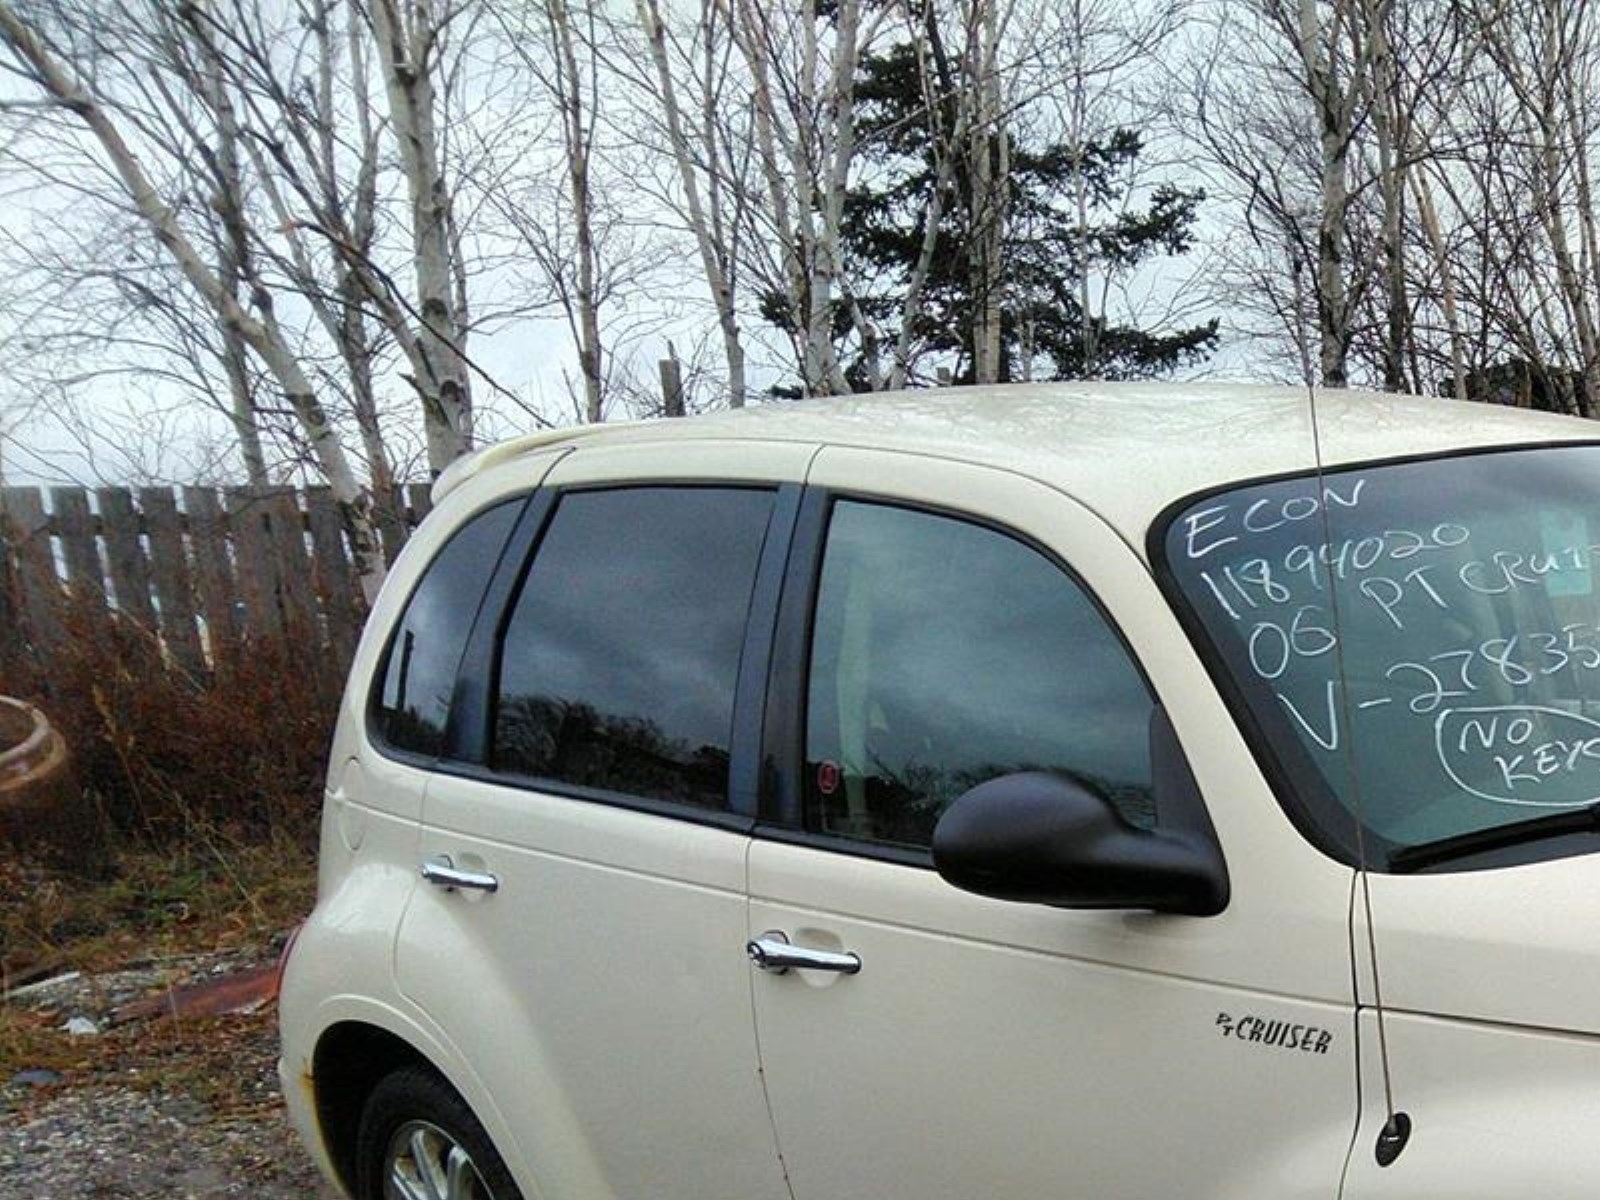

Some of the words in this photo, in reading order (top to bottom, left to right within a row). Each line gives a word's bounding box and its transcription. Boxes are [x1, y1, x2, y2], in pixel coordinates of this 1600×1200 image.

[1185, 479, 1365, 558] ECON
[1200, 523, 1470, 620] 11894020
[1249, 605, 1339, 679] 06
[1359, 564, 1449, 630] PT
[1458, 717, 1533, 753] NO
[1235, 1015, 1333, 1055] CRUISER
